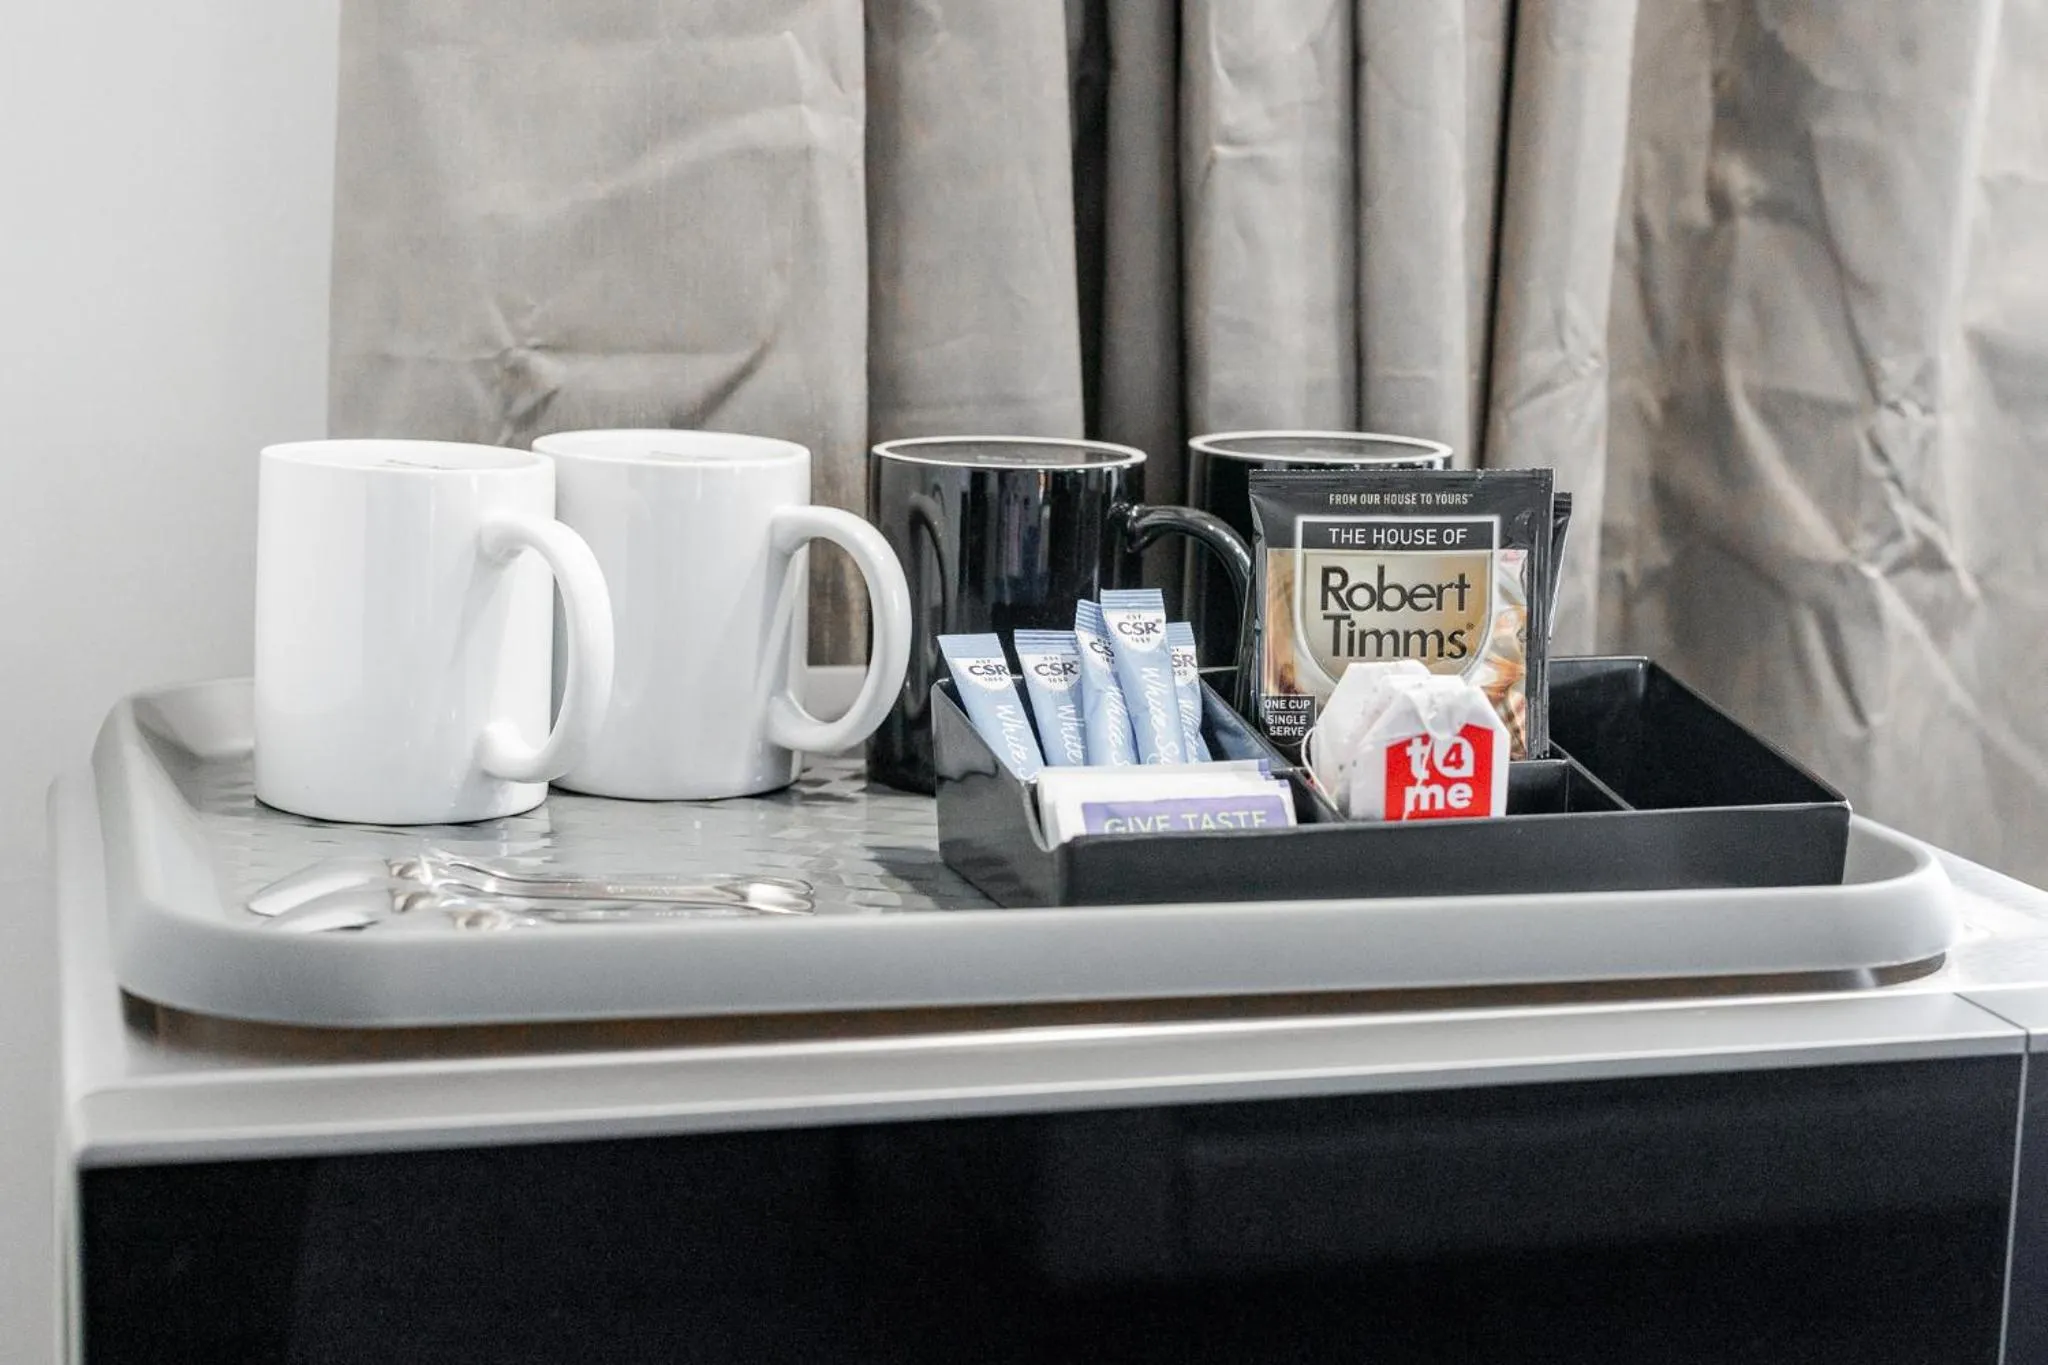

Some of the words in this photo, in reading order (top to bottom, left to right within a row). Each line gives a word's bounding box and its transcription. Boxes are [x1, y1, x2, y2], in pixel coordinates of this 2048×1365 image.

[1329, 493, 1357, 505] FROM
[1360, 493, 1380, 505] OUR
[1383, 493, 1417, 505] HOUSE
[1420, 493, 1433, 505] TO
[1328, 528, 1366, 544] THE
[1373, 528, 1437, 545] HOUSE
[1443, 528, 1468, 544] OF
[1321, 564, 1470, 612] Robert
[1117, 621, 1161, 635] CSR
[1323, 613, 1467, 659] Timms
[968, 664, 1010, 676] CSR
[1034, 662, 1078, 677] CSR
[1264, 699, 1287, 710] ONE
[1288, 699, 1311, 709] CUP
[1266, 714, 1307, 725] SINGLE
[996, 704, 1028, 764] White
[1057, 704, 1086, 764] White
[1270, 725, 1305, 737] SERVE
[1404, 783, 1474, 812] me
